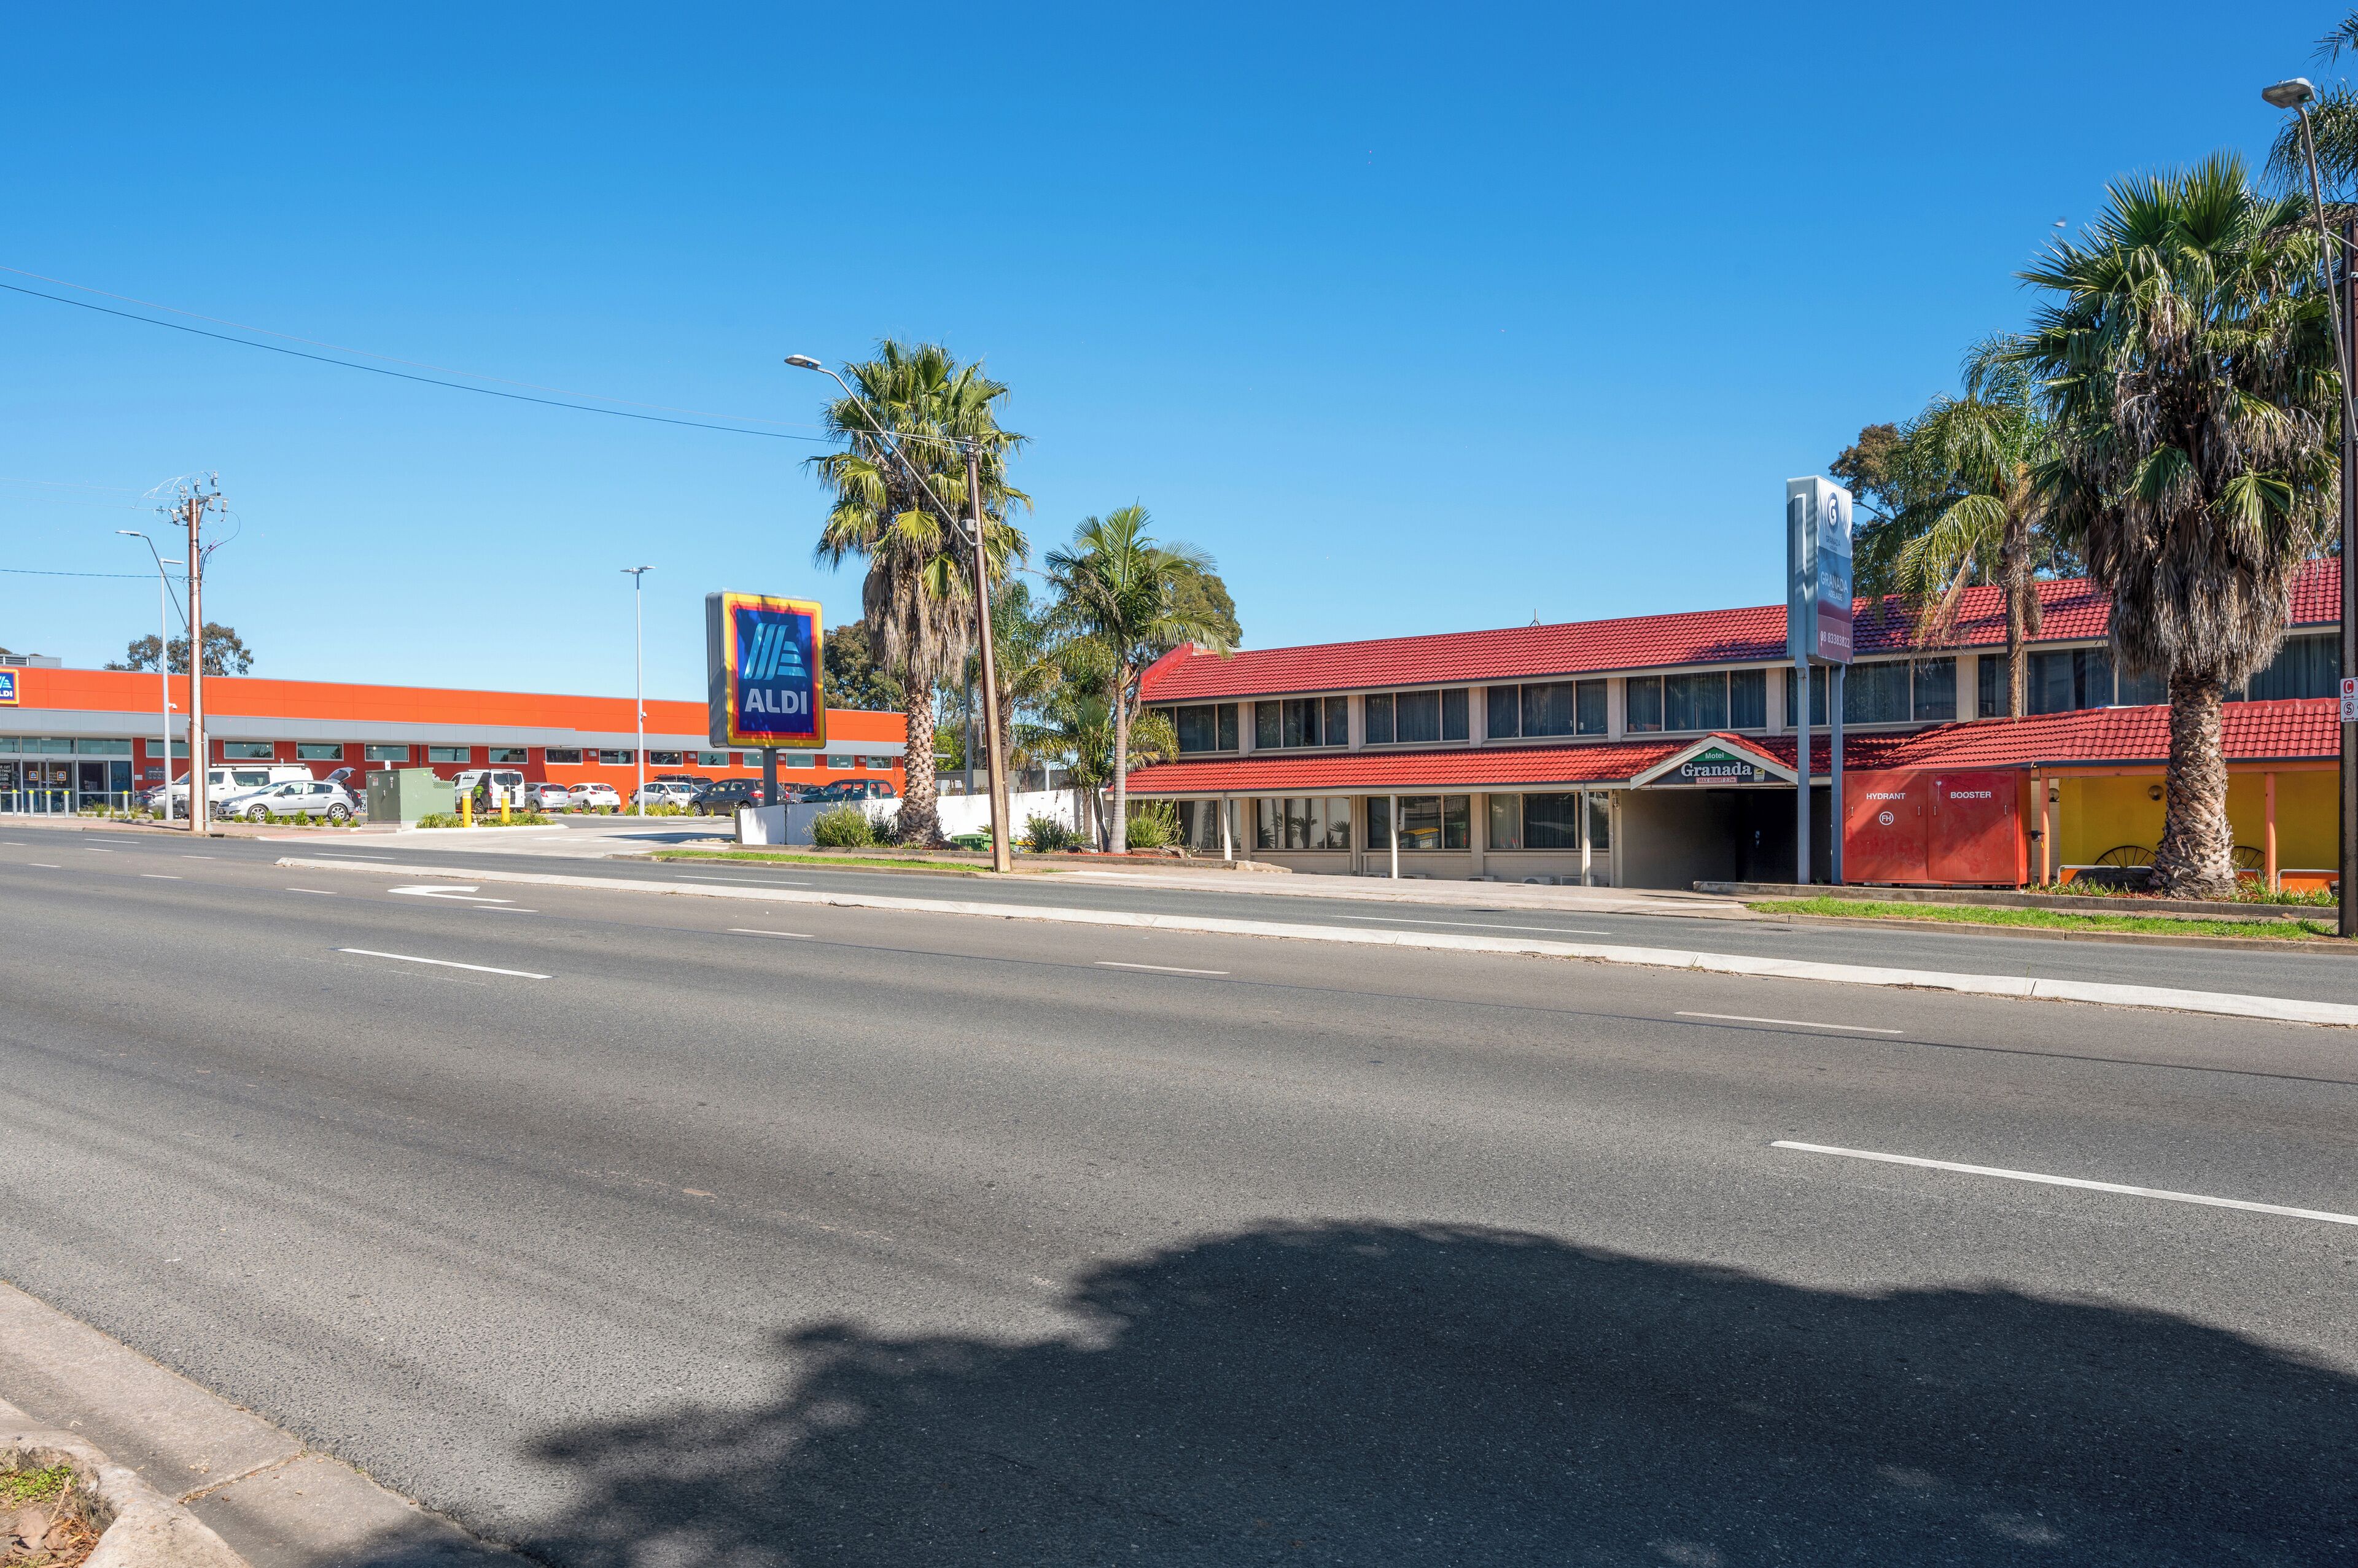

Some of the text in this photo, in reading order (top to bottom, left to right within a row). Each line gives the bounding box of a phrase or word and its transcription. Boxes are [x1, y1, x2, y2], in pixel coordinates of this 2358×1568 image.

[1829, 499, 1837, 526] G
[1820, 571, 1848, 594] GRANADA
[1828, 590, 1843, 602] ADELAIDE
[1820, 631, 1850, 648] 08 83383822
[2346, 681, 2351, 693] C
[744, 688, 807, 715] ALDI
[1681, 762, 1753, 777] Granada
